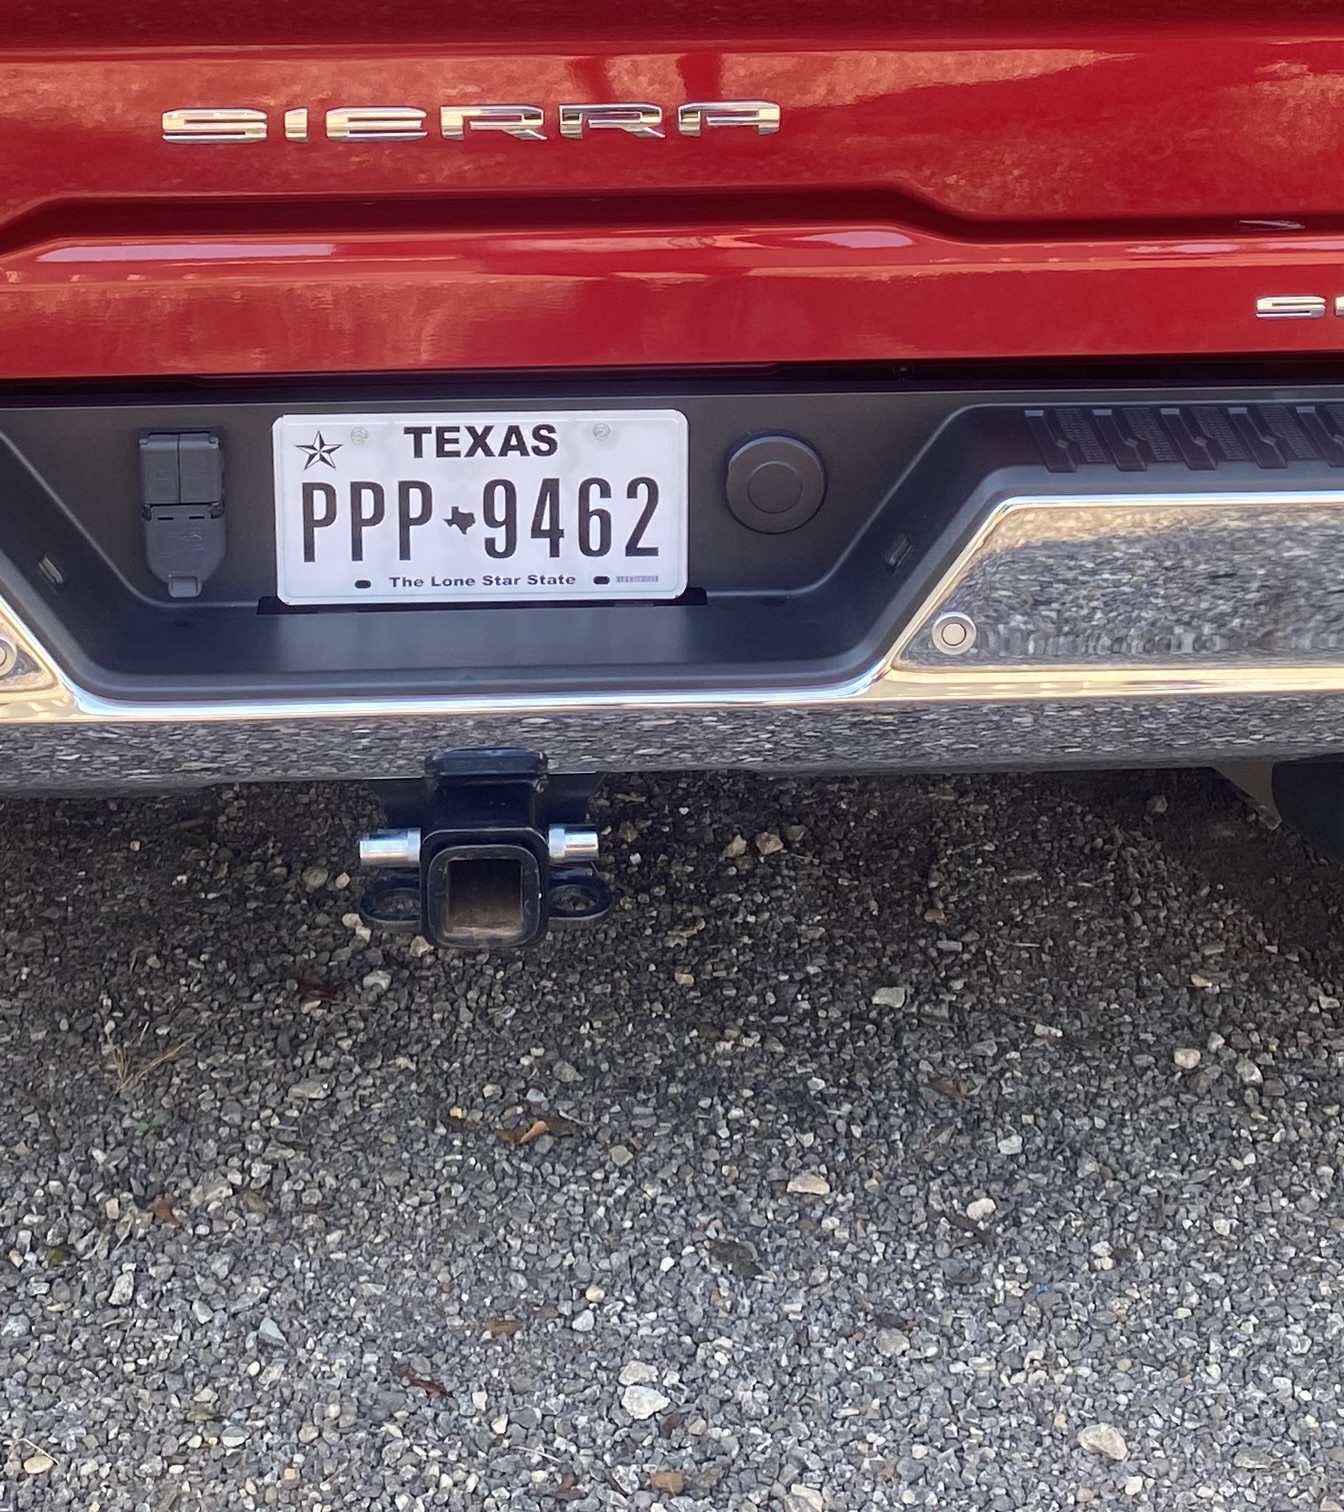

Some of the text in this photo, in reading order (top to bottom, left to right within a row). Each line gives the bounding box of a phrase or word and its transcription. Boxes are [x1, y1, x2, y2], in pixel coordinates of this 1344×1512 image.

[161, 101, 781, 143] SIERRA
[403, 424, 558, 459] TEXAS
[302, 476, 660, 563] PPP 9462
[389, 574, 576, 588] The Lone Star State
